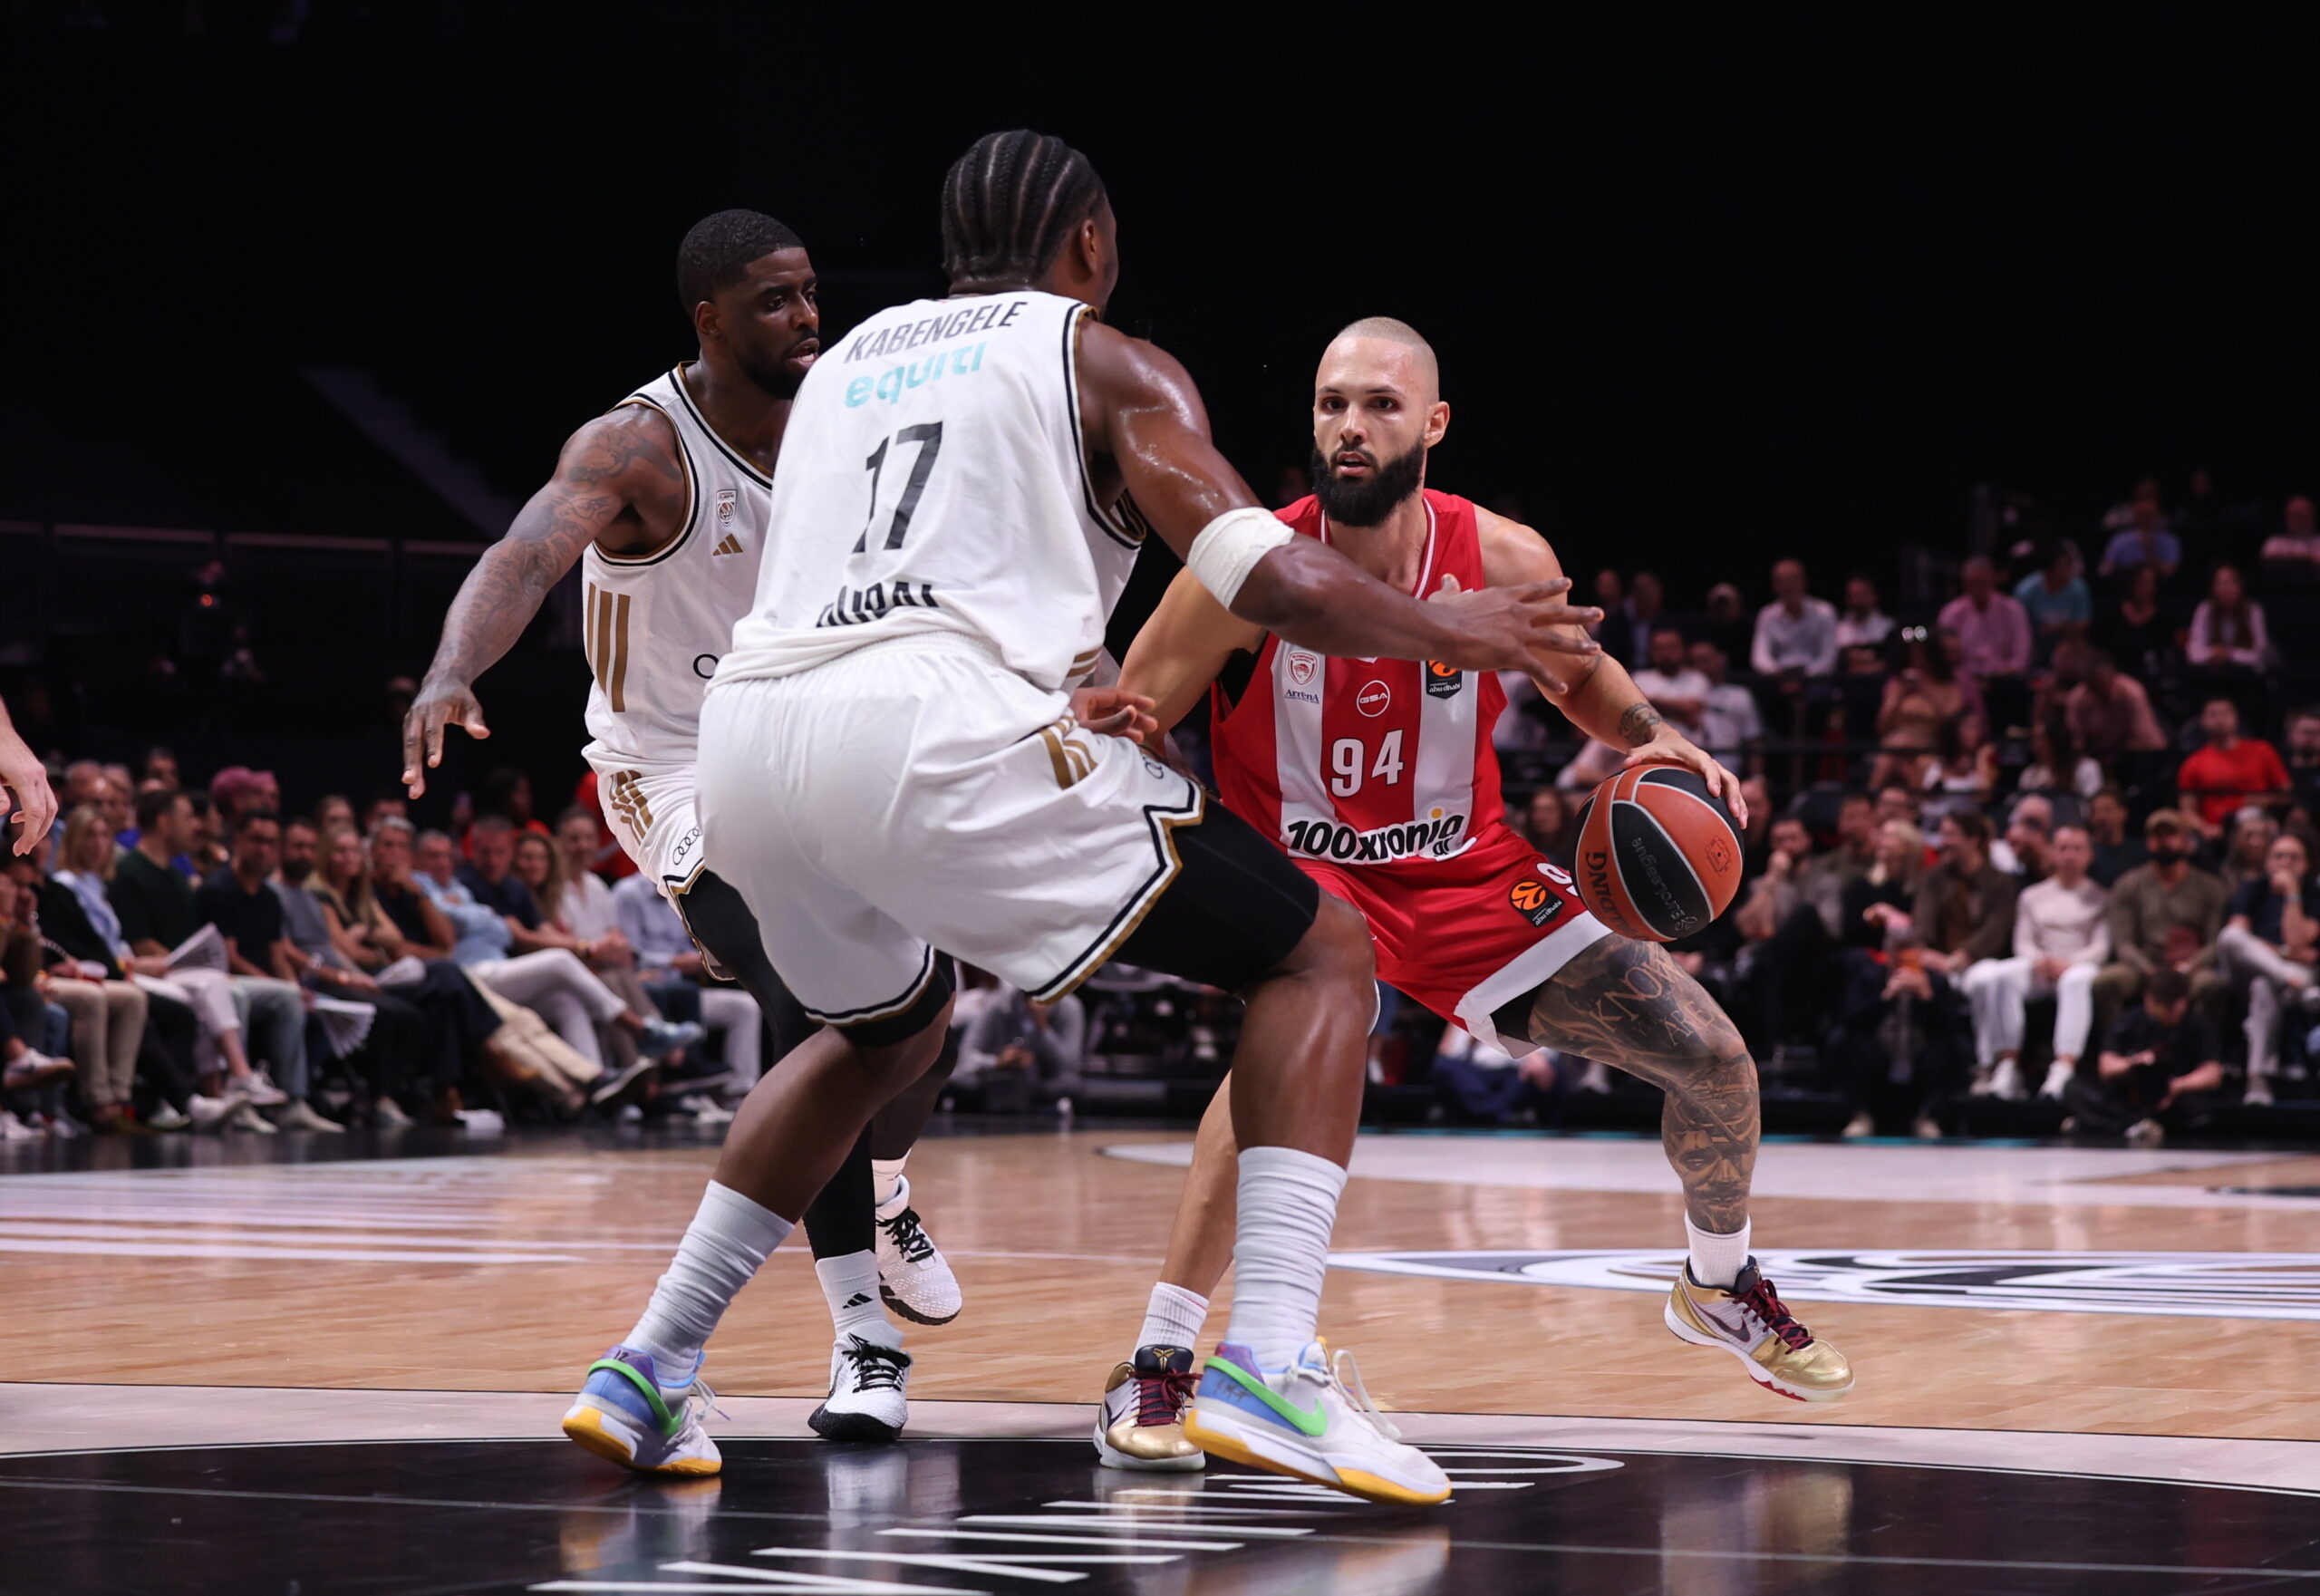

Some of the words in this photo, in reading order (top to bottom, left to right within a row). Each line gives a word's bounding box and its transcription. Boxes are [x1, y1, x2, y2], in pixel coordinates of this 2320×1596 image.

[844, 301, 1028, 363] KABENGELE
[845, 342, 987, 408] equiti
[851, 421, 943, 554] 17
[1359, 692, 1388, 704] GSA
[1331, 729, 1404, 798] 94
